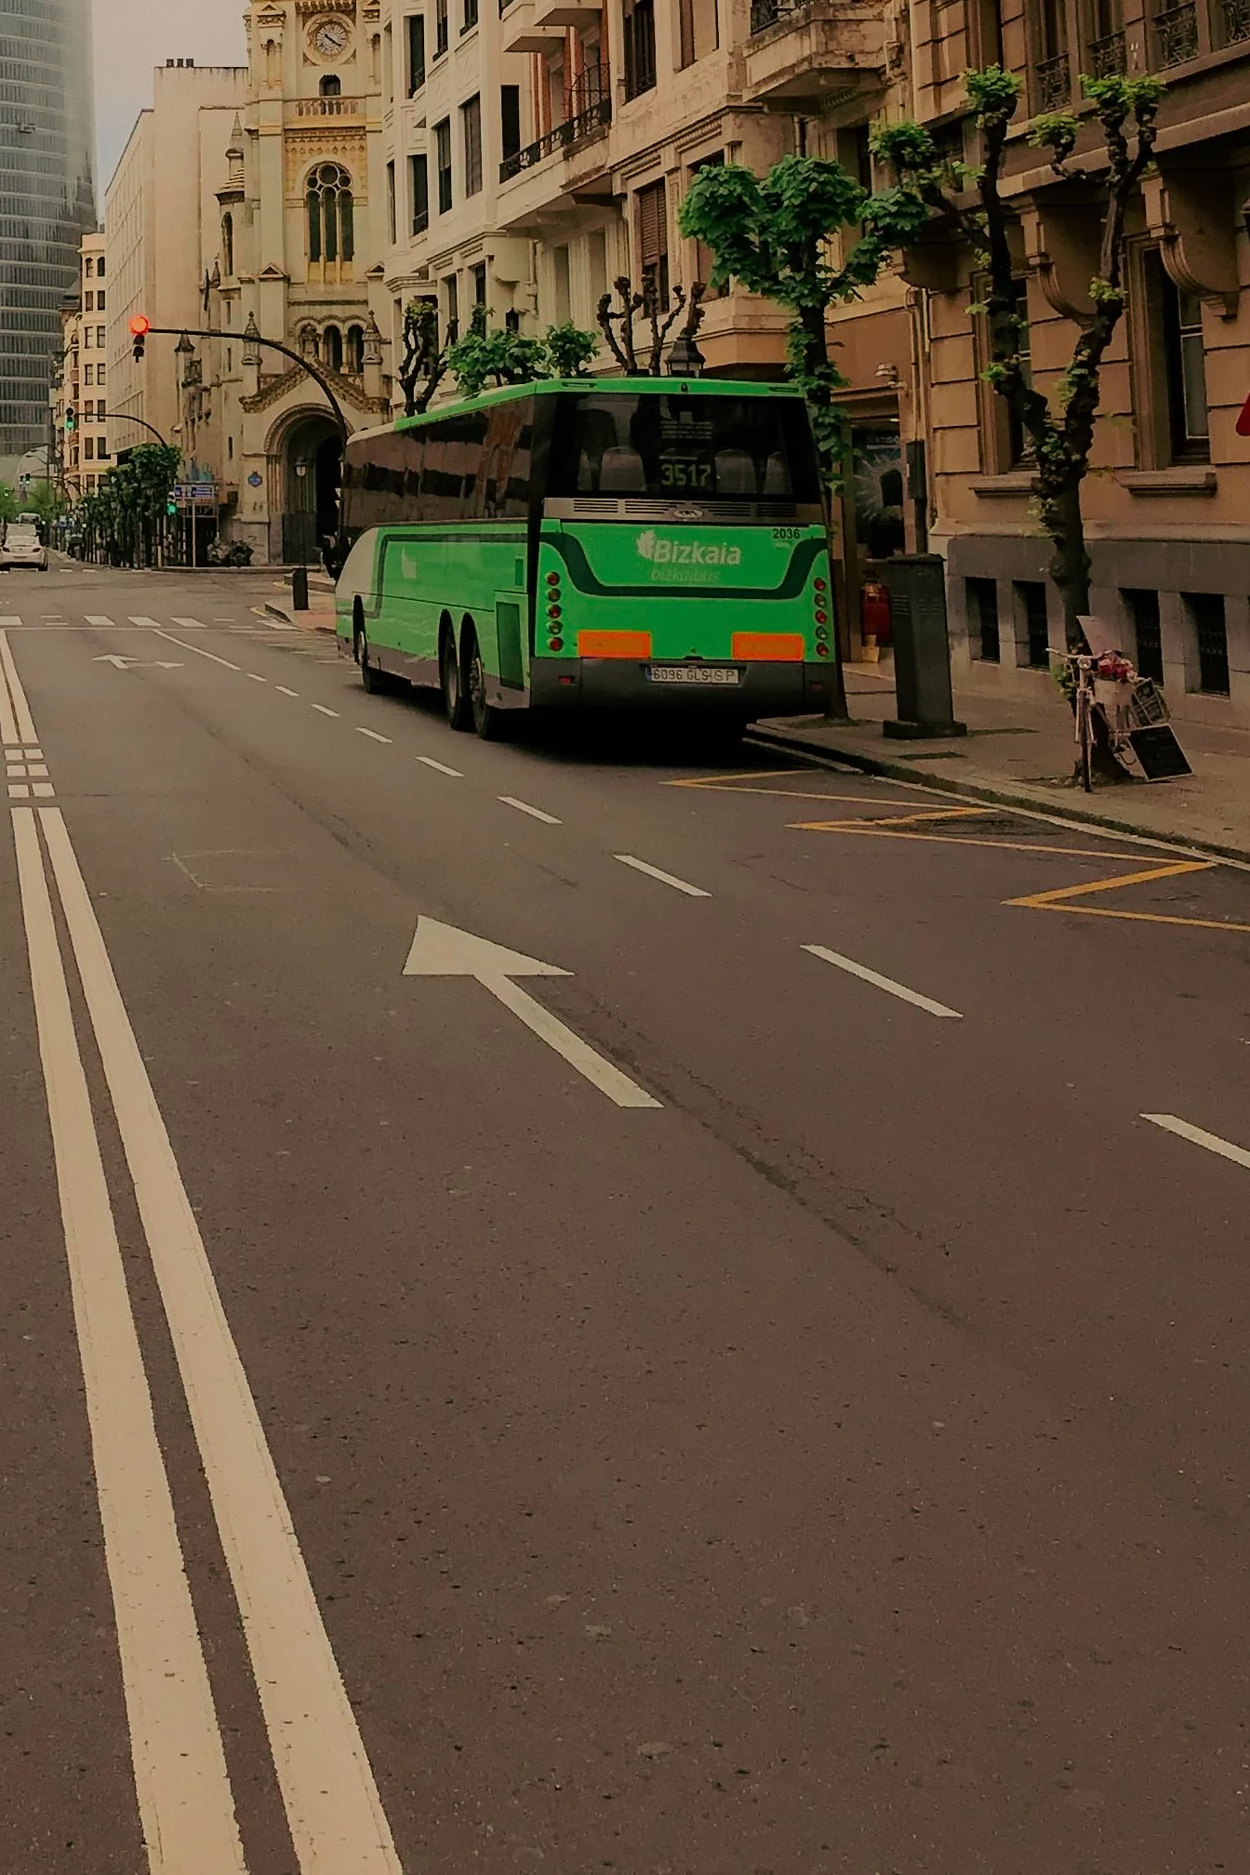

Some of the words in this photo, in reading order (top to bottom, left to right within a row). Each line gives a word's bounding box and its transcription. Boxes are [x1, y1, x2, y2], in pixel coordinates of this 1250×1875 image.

[661, 463, 711, 487] 3517
[772, 528, 800, 539] 2036
[653, 539, 742, 566] Bizkaia
[653, 669, 683, 680] 6096
